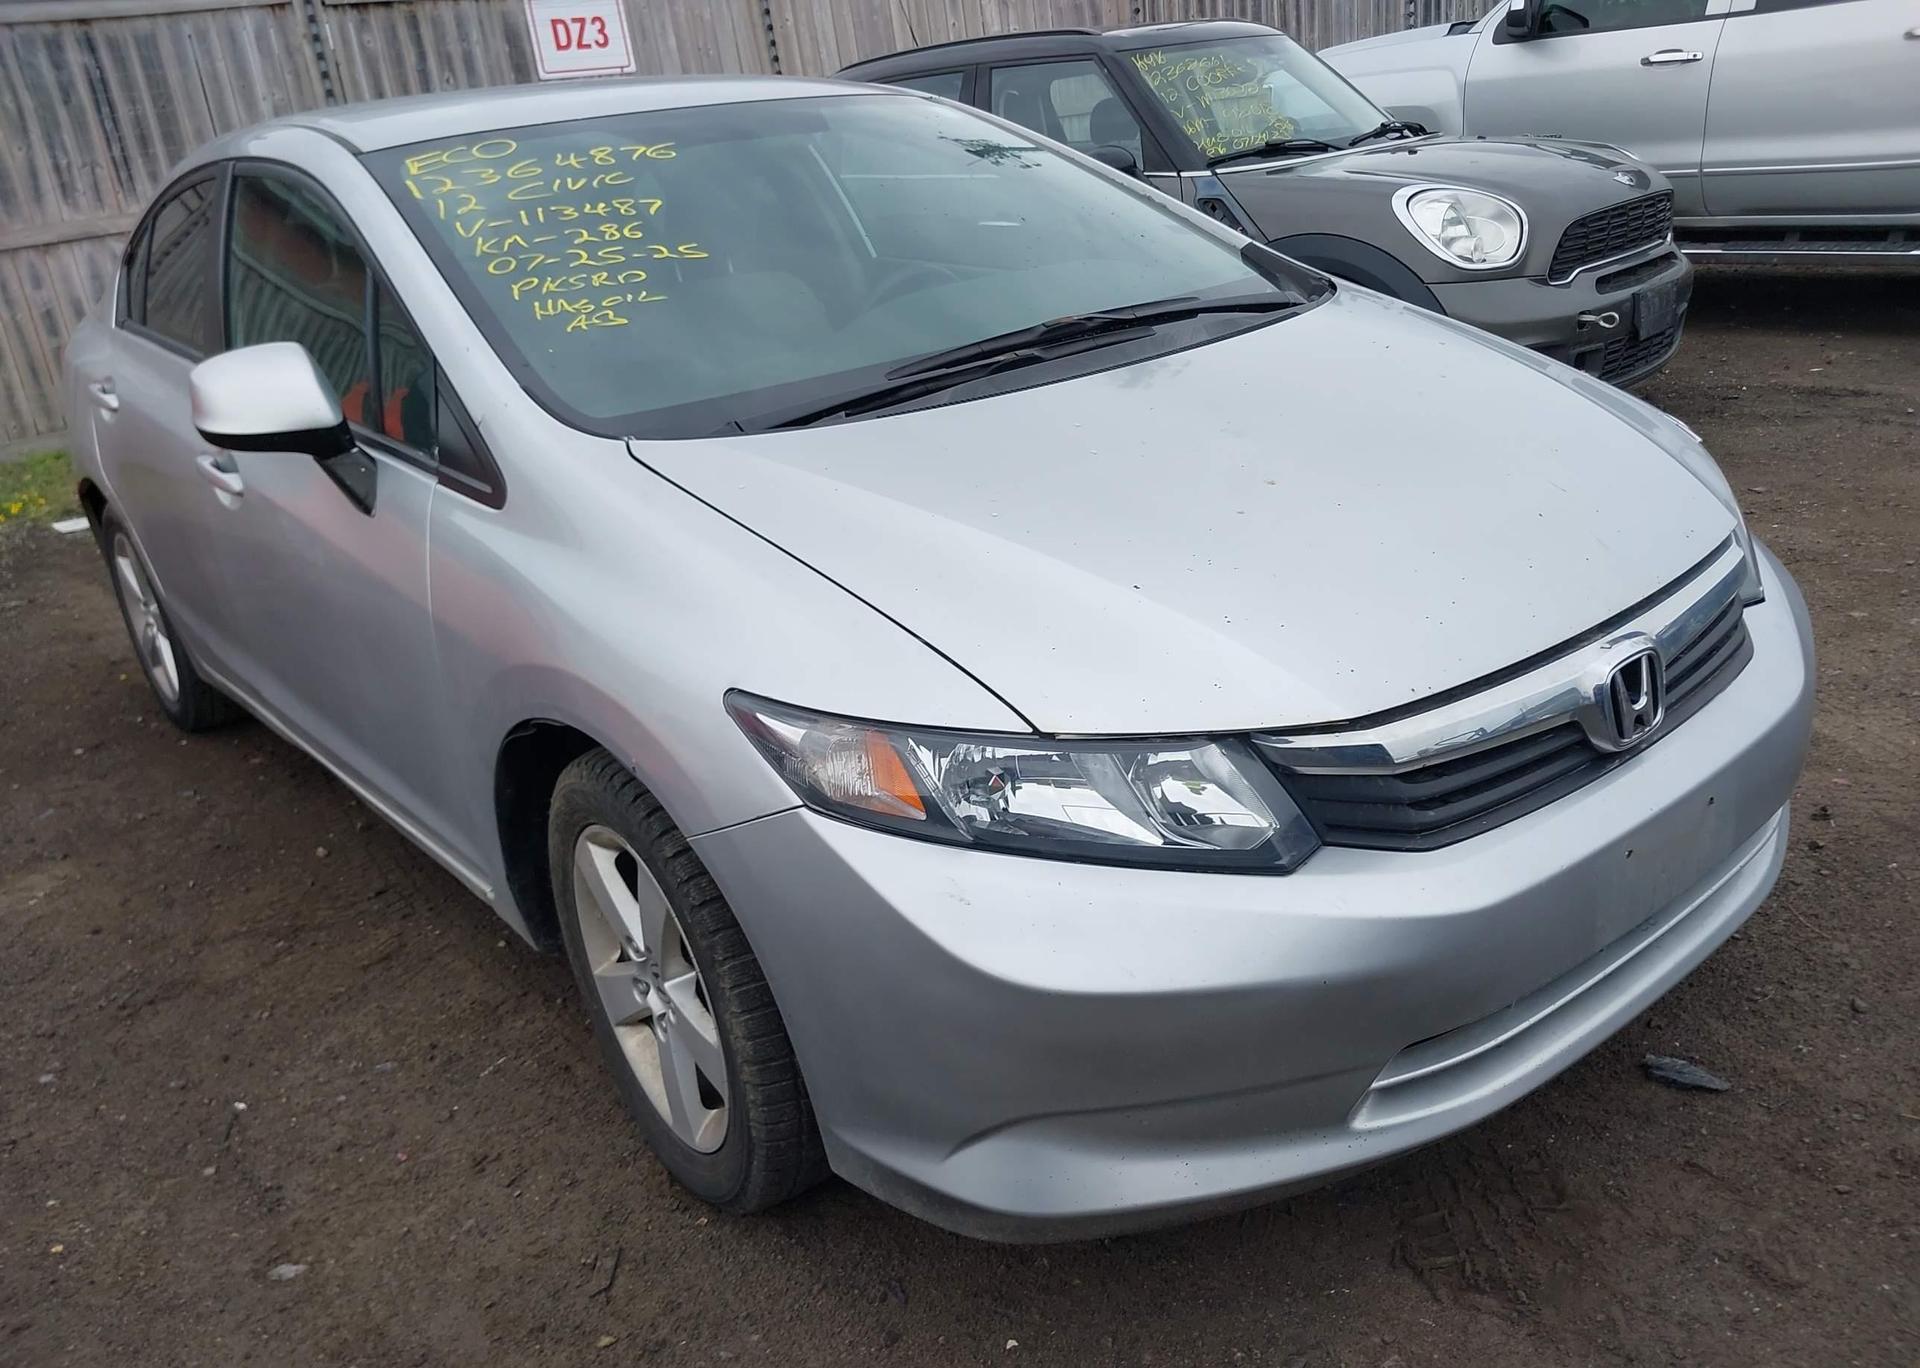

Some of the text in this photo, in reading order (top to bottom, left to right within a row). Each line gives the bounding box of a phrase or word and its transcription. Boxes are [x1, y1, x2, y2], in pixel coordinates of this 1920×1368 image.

[550, 16, 609, 51] DZ3
[405, 139, 518, 175] ECO
[436, 171, 636, 220] 12 CIVIC
[487, 243, 710, 275] 07-25-25
